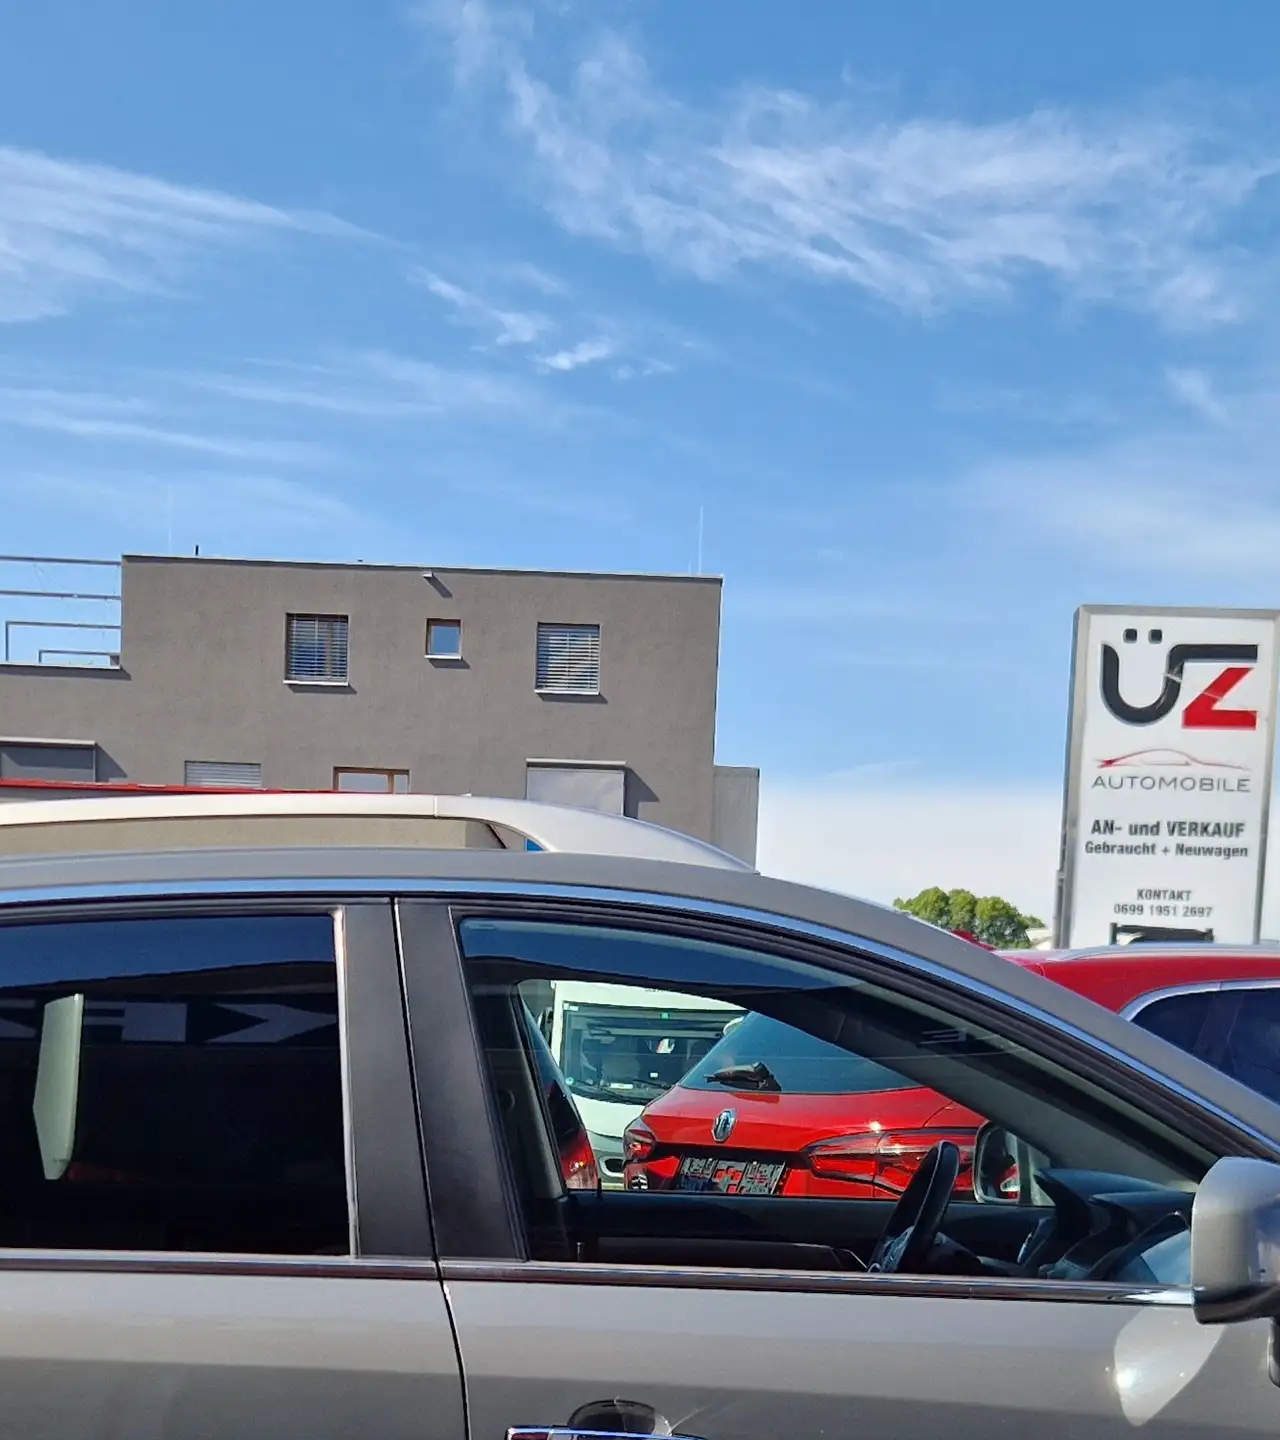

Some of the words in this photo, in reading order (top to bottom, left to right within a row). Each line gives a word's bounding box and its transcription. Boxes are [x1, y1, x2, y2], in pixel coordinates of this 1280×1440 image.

[1091, 774, 1252, 793] AUTOMOBILE
[1090, 819, 1123, 836] AN-
[1128, 821, 1160, 836] und
[1167, 821, 1246, 839] VERKAUF
[1084, 841, 1157, 856] Gebraucht
[1175, 843, 1249, 860] Neuwagen
[1136, 888, 1193, 902] KONTAKT
[1113, 903, 1145, 916] 0699
[1149, 905, 1178, 917] 1951
